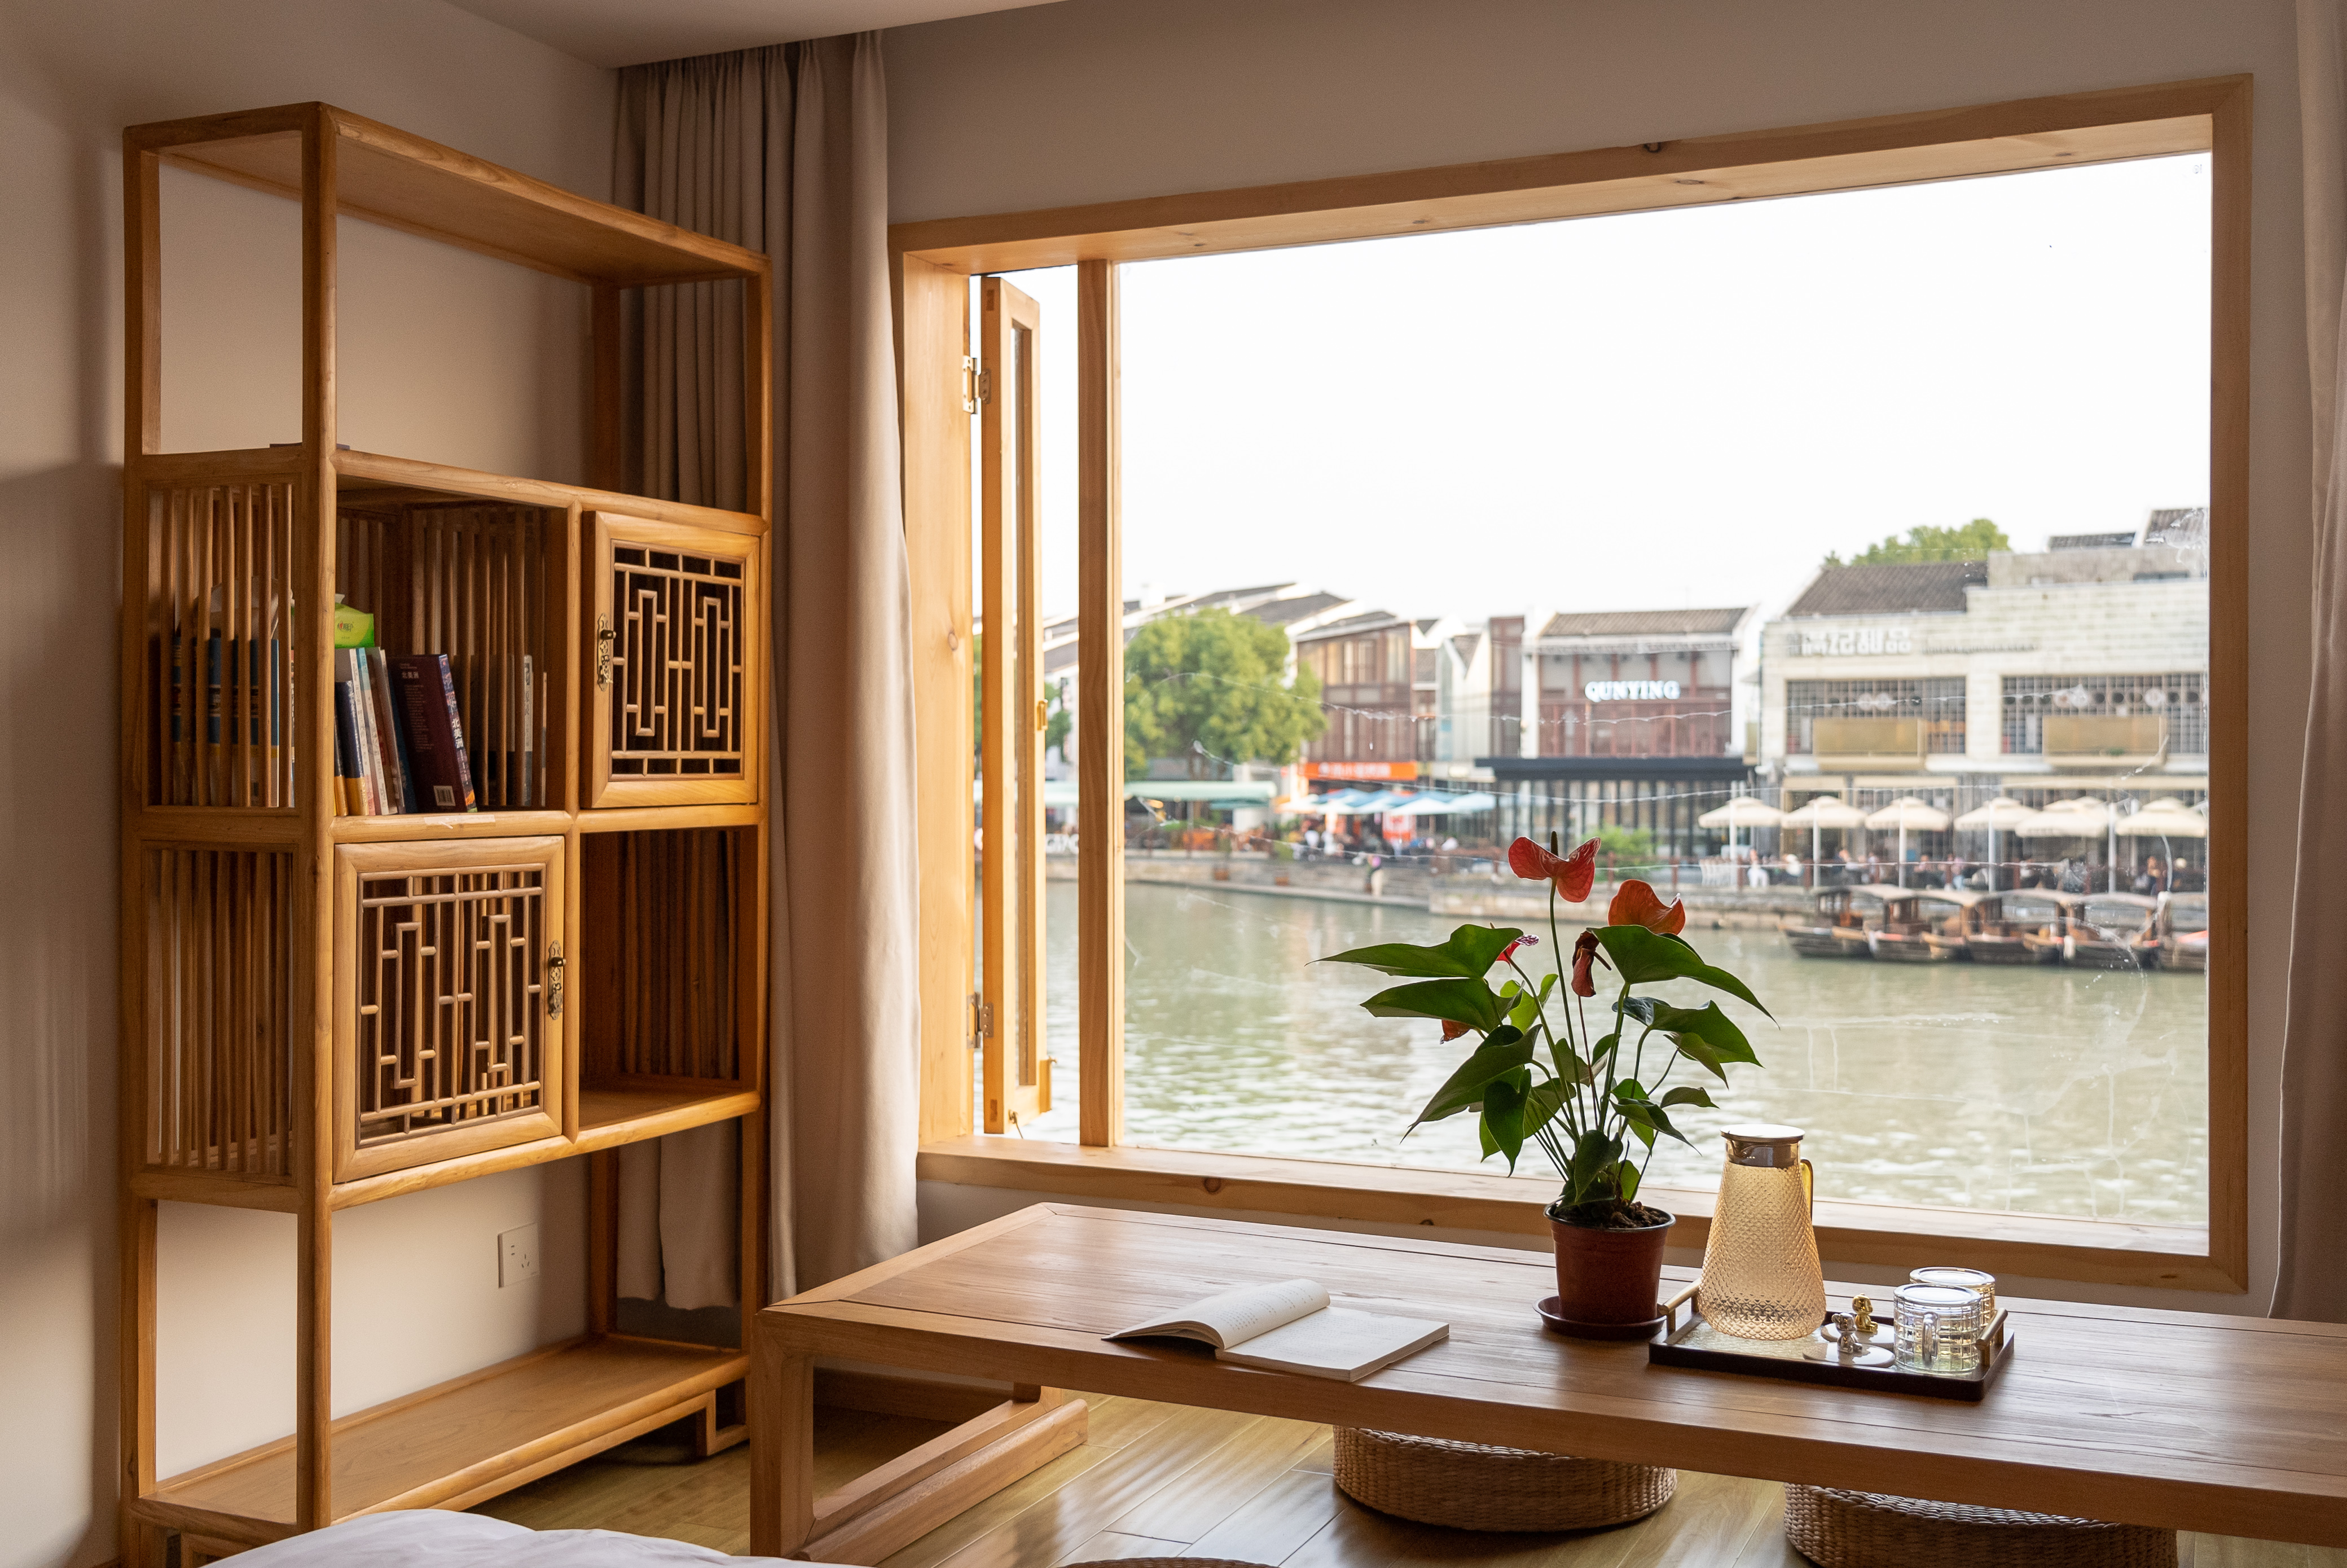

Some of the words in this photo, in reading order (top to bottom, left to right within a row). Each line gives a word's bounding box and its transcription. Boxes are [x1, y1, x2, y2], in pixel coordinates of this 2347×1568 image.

[1585, 680, 1680, 702] QUNYING
[452, 718, 464, 748] 北美洲
